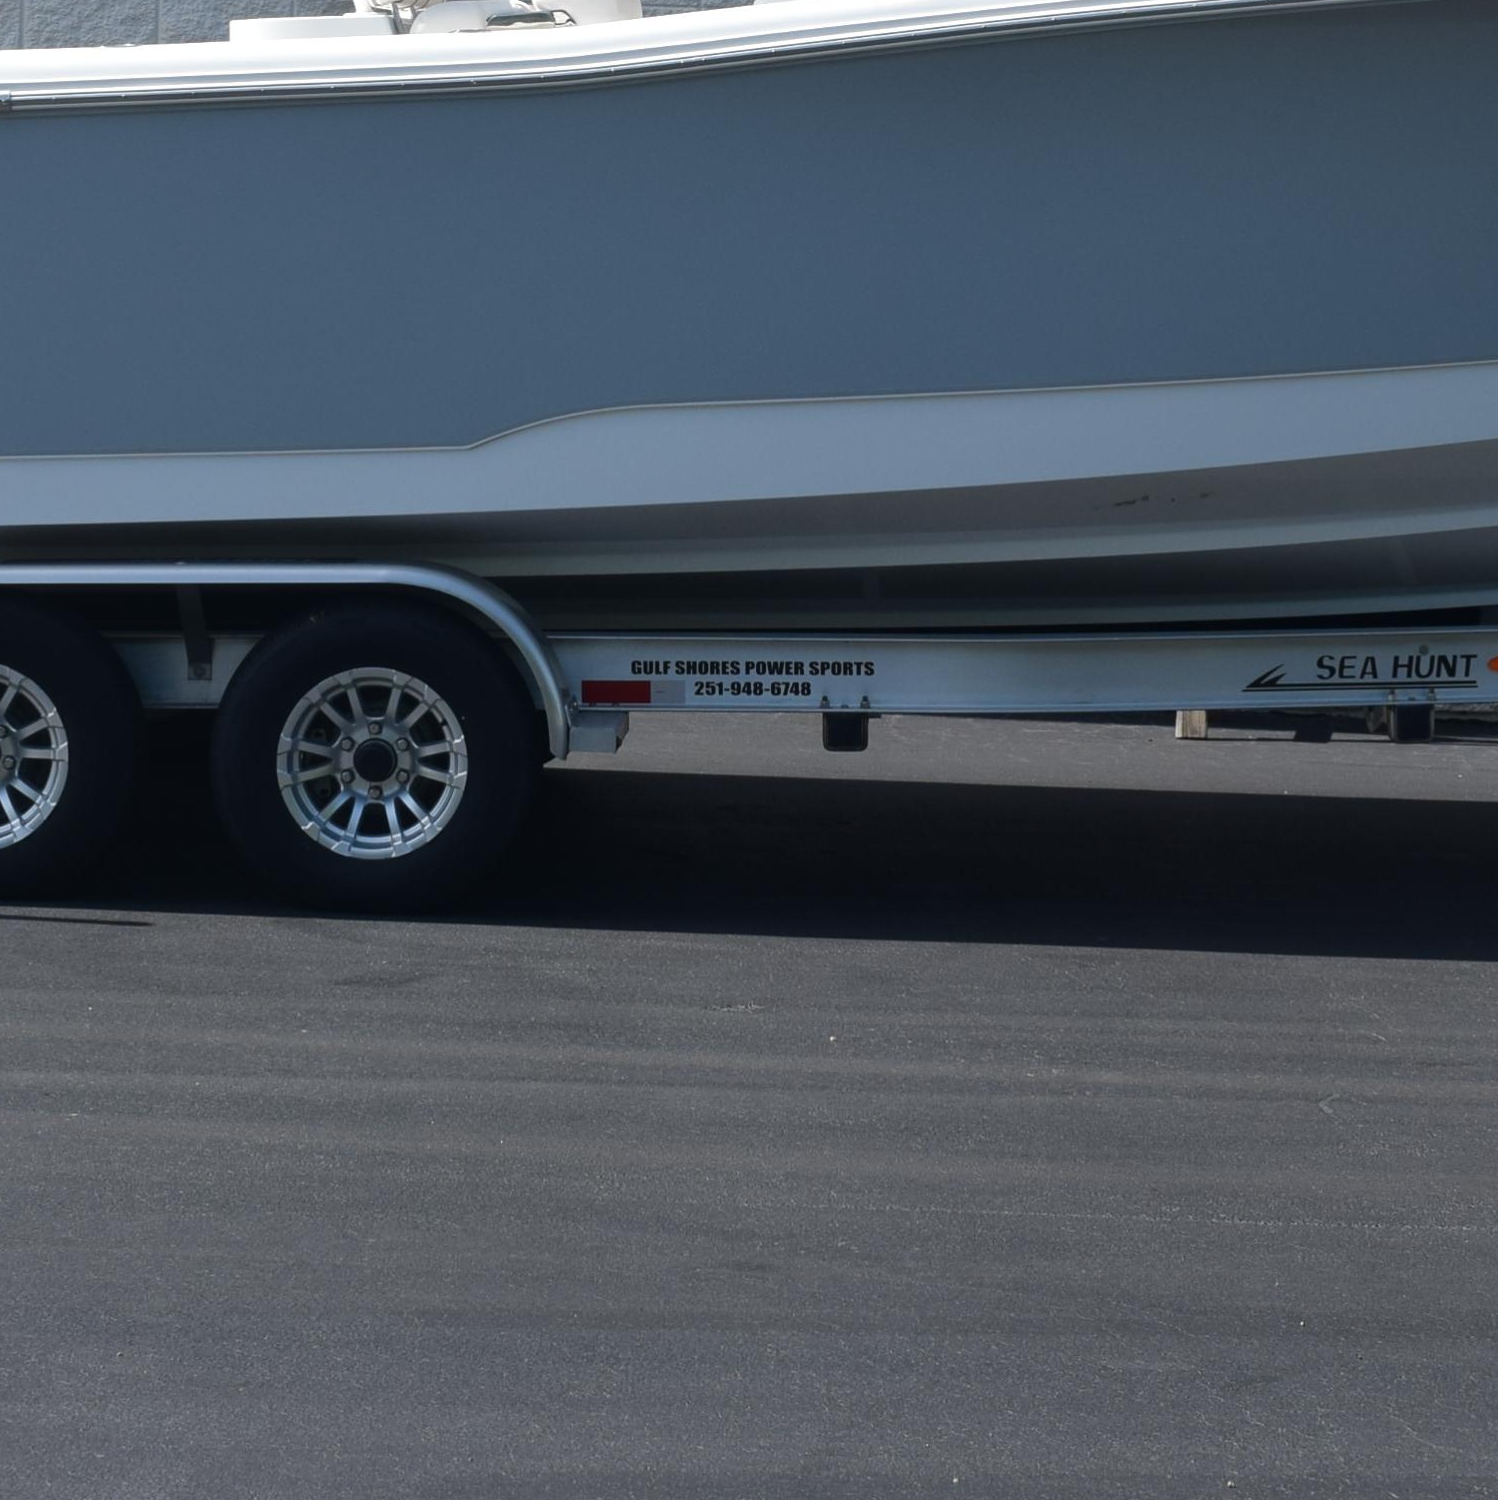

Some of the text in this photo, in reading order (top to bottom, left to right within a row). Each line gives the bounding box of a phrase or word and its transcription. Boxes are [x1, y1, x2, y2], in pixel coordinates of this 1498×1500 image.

[631, 660, 875, 677] GULF SHORES POWER SPORTS
[1316, 654, 1478, 680] SEA HUNT
[694, 681, 812, 697] 251-948-6748
